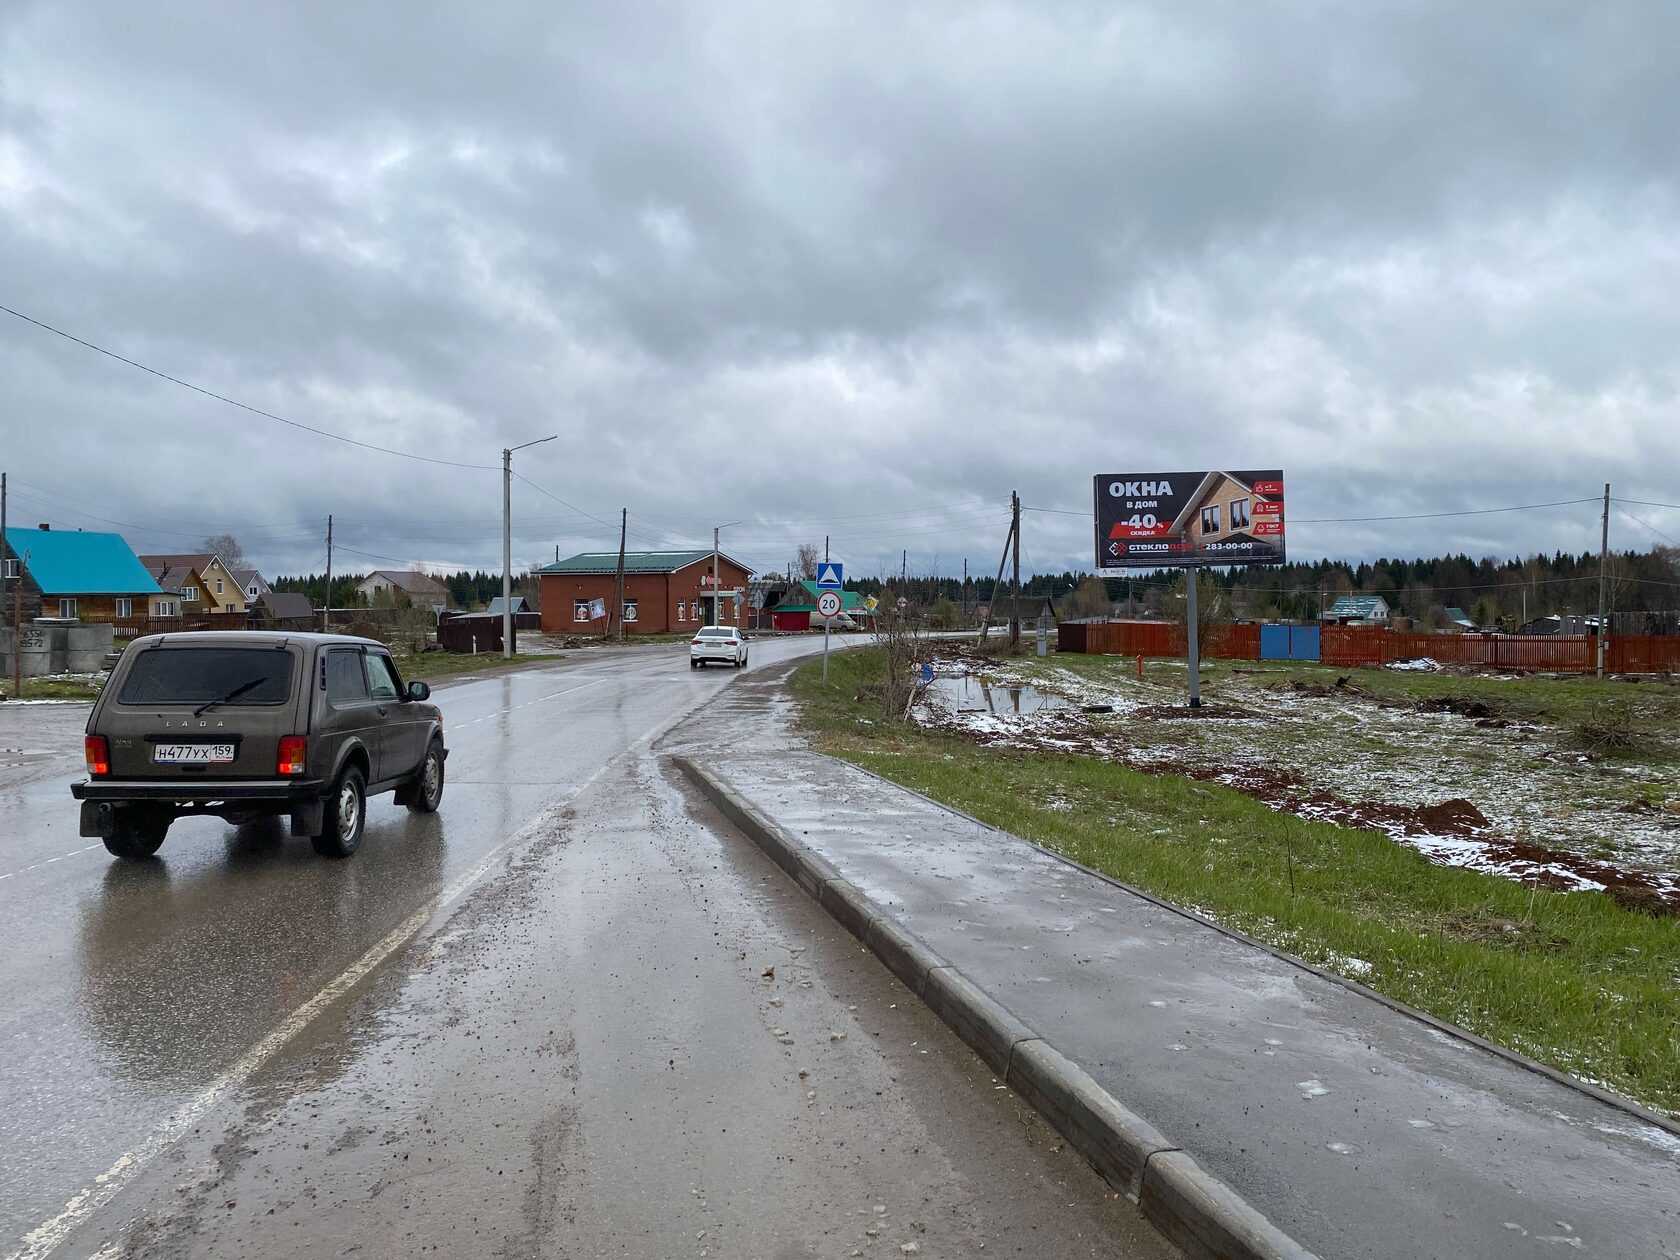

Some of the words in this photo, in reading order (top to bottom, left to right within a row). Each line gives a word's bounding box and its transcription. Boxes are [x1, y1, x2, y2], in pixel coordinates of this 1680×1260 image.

[1109, 481, 1173, 497] ОКНА
[1206, 542, 1252, 550] 283-00-00
[822, 599, 836, 609] 20
[158, 746, 209, 760] Н477УХ
[212, 746, 232, 756] 159
